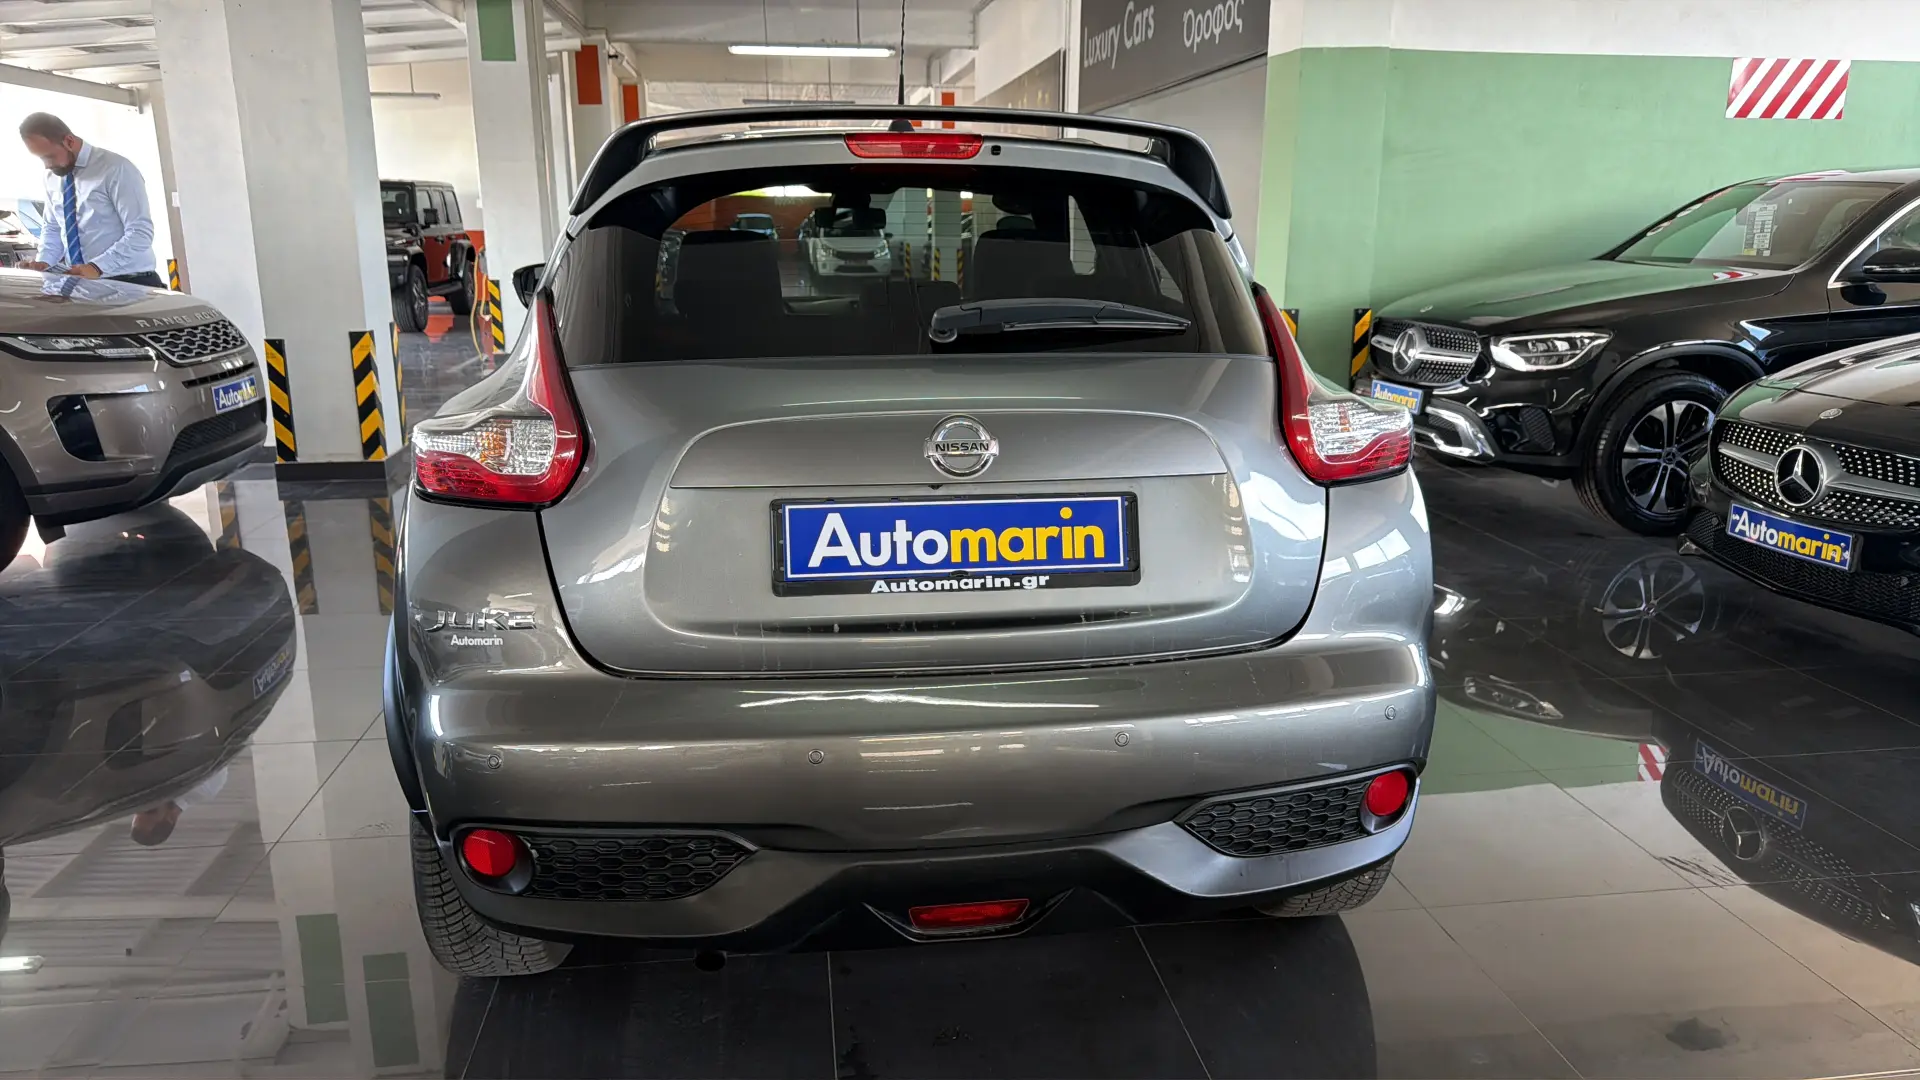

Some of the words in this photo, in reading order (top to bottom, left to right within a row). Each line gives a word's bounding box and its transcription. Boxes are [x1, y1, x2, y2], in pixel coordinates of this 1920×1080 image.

[1083, 23, 1121, 69] Luxury
[1124, 1, 1155, 49] Cars
[136, 315, 192, 328] RANGE
[1374, 383, 1417, 410] Automarin
[935, 442, 989, 452] NISSAN
[807, 506, 1105, 568] Automarin
[1734, 510, 1842, 563] Automarin
[871, 574, 1050, 593] Automarin.gr
[424, 607, 537, 632] JUKE
[450, 634, 503, 646] Automarin
